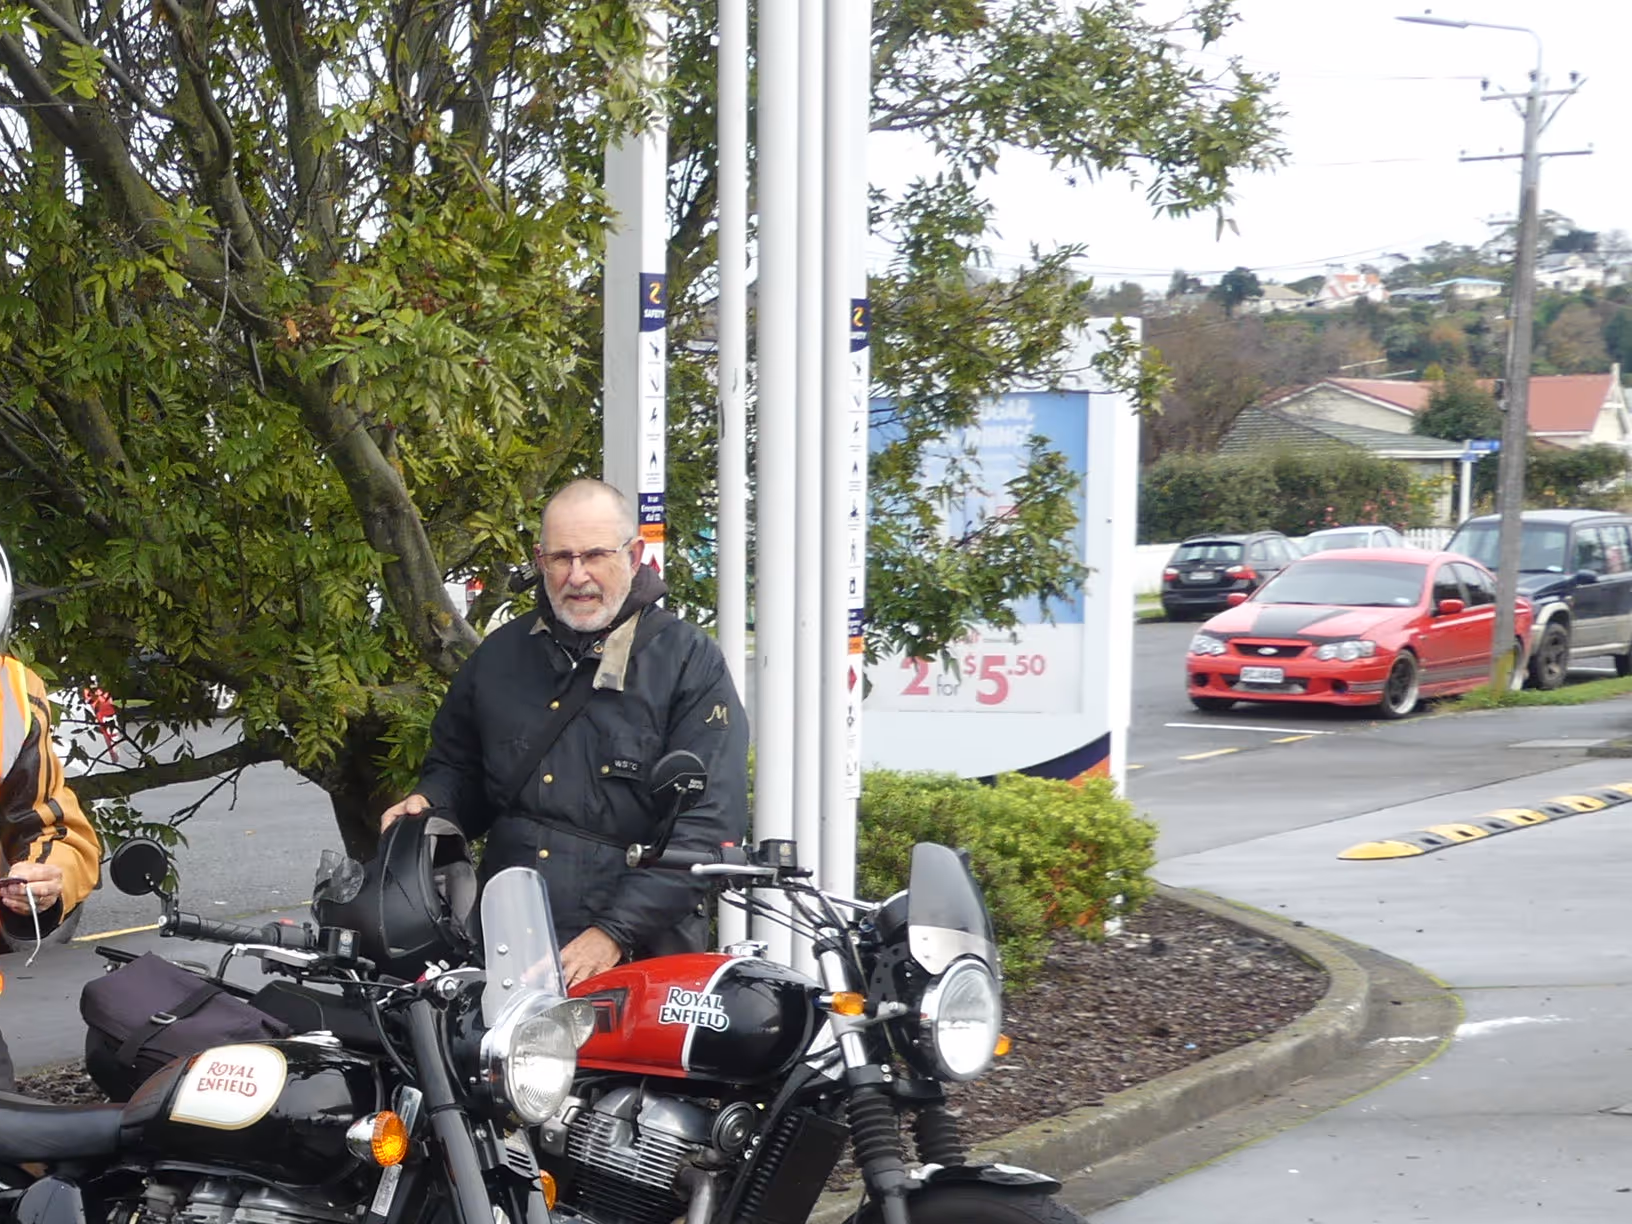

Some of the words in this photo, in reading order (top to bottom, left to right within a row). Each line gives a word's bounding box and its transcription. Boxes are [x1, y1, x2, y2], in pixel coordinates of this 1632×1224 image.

[900, 655, 930, 695] 2
[936, 674, 960, 696] for
[669, 988, 724, 1010] ROYAL
[660, 1007, 729, 1030] ENFIELD
[207, 1061, 254, 1079] ROYAL
[196, 1077, 258, 1098] ENFIELD
